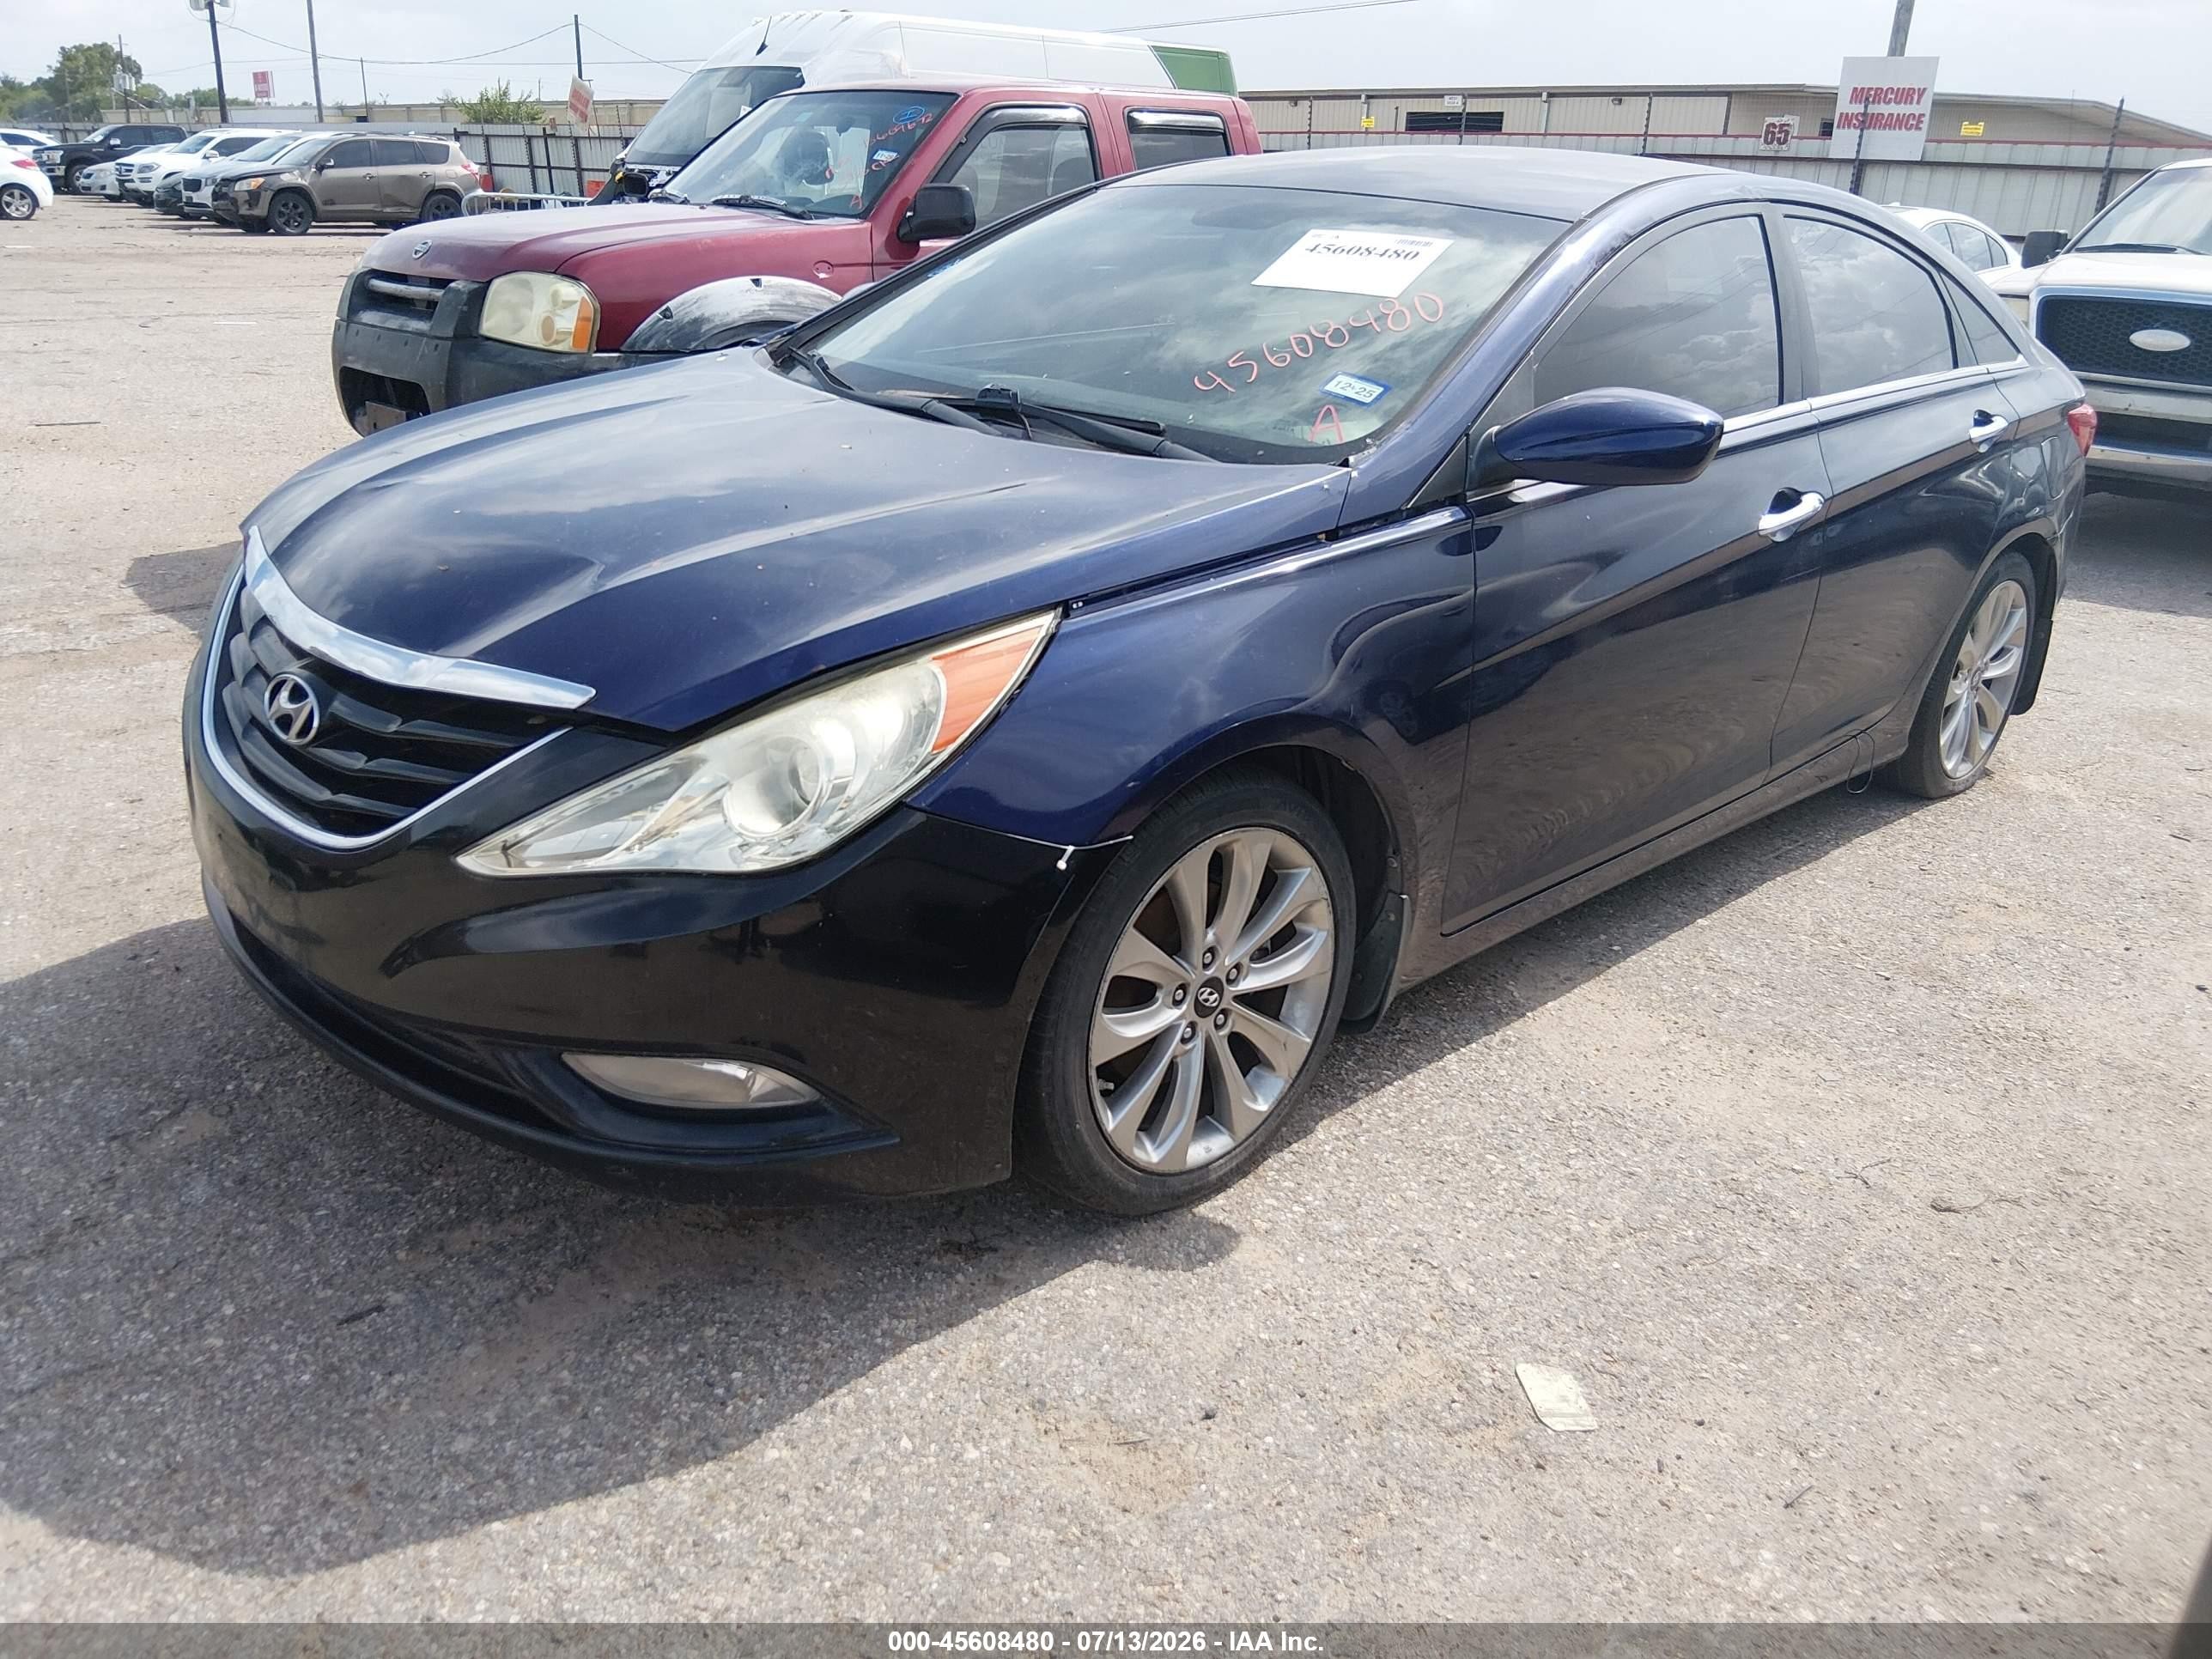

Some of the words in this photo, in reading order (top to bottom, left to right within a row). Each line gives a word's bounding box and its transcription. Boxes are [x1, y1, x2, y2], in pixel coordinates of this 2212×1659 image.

[1849, 86, 1927, 106] MERCURY
[1836, 112, 1925, 131] INSURANCE
[1763, 122, 1791, 146] 65
[1304, 242, 1420, 260] 45608480
[1194, 292, 1443, 392] 45608480
[1307, 404, 1346, 445] A
